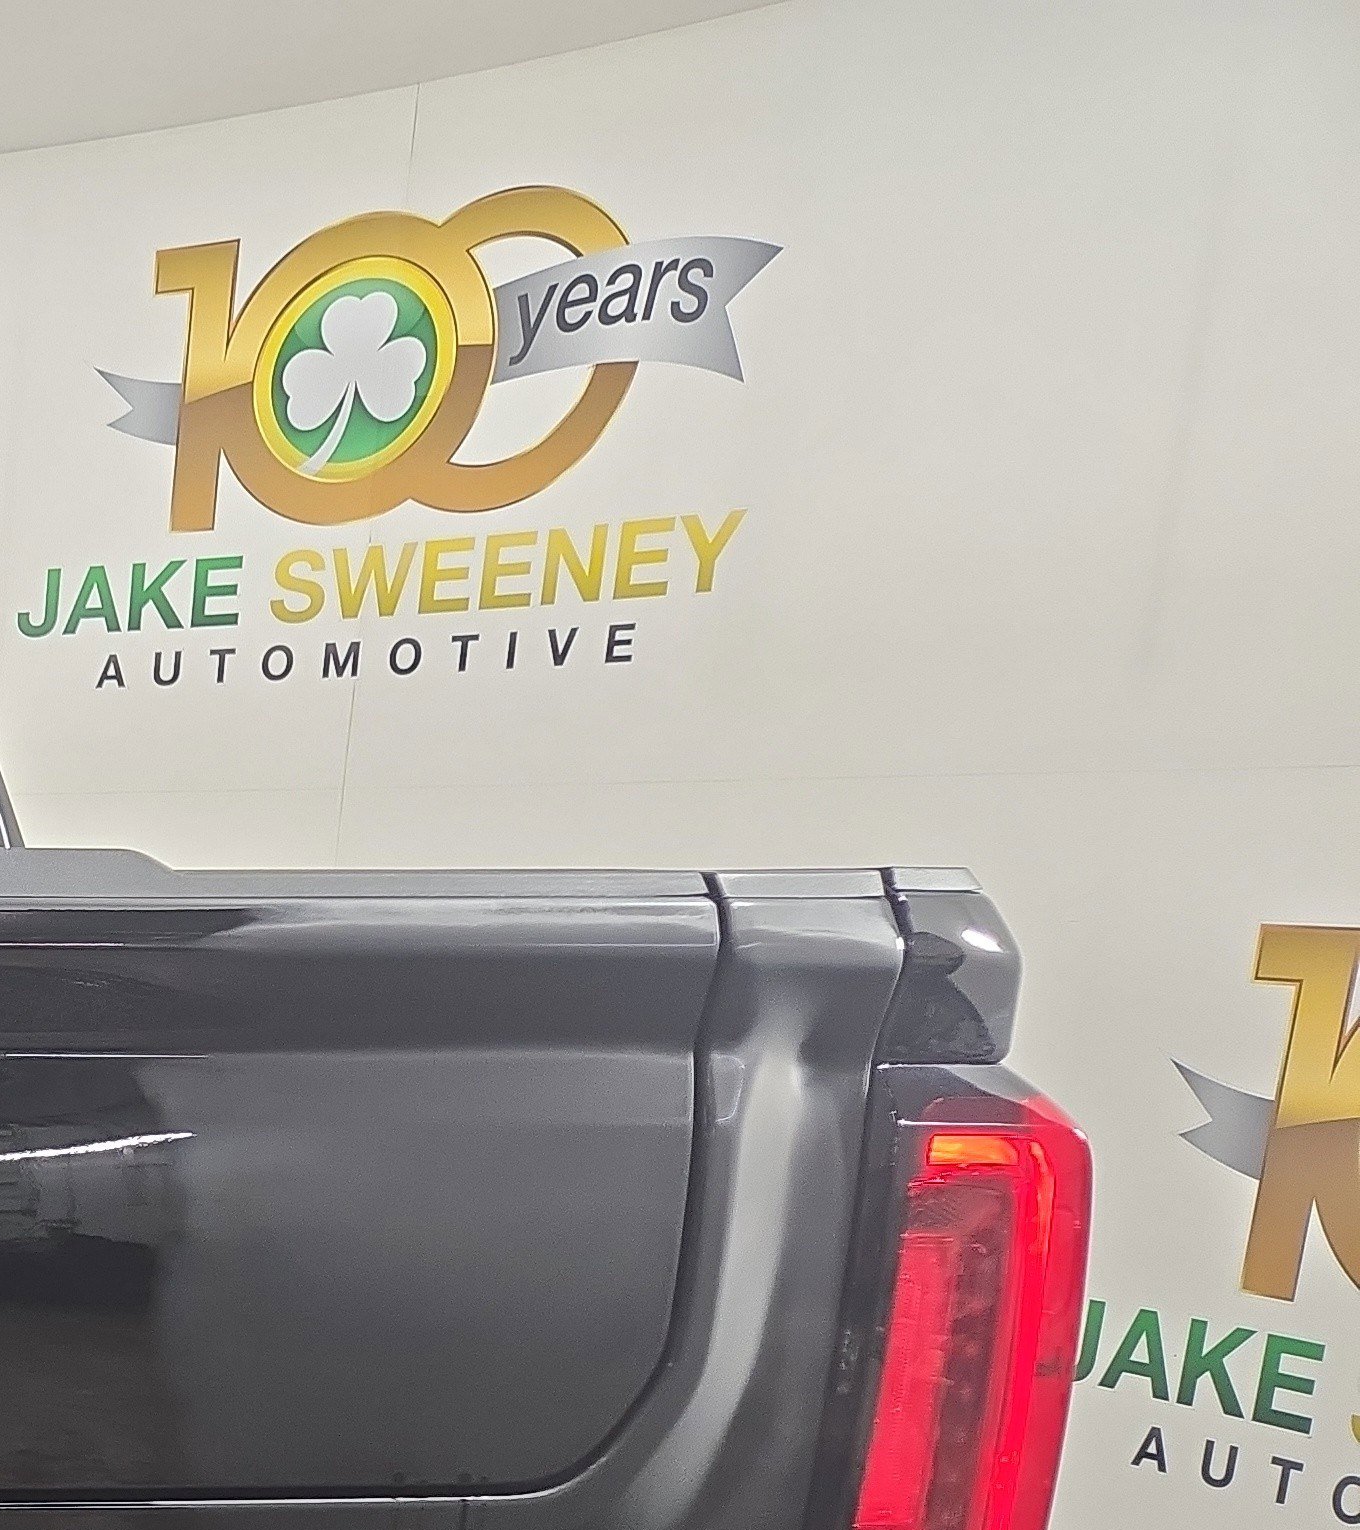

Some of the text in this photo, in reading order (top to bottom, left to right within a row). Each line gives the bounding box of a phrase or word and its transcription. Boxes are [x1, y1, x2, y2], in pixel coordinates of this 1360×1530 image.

[508, 254, 715, 366] years
[16, 509, 748, 640] JAKE SWEENEY
[95, 622, 638, 689] AUTOMOTIVE
[1130, 1425, 1360, 1525] AUTO
